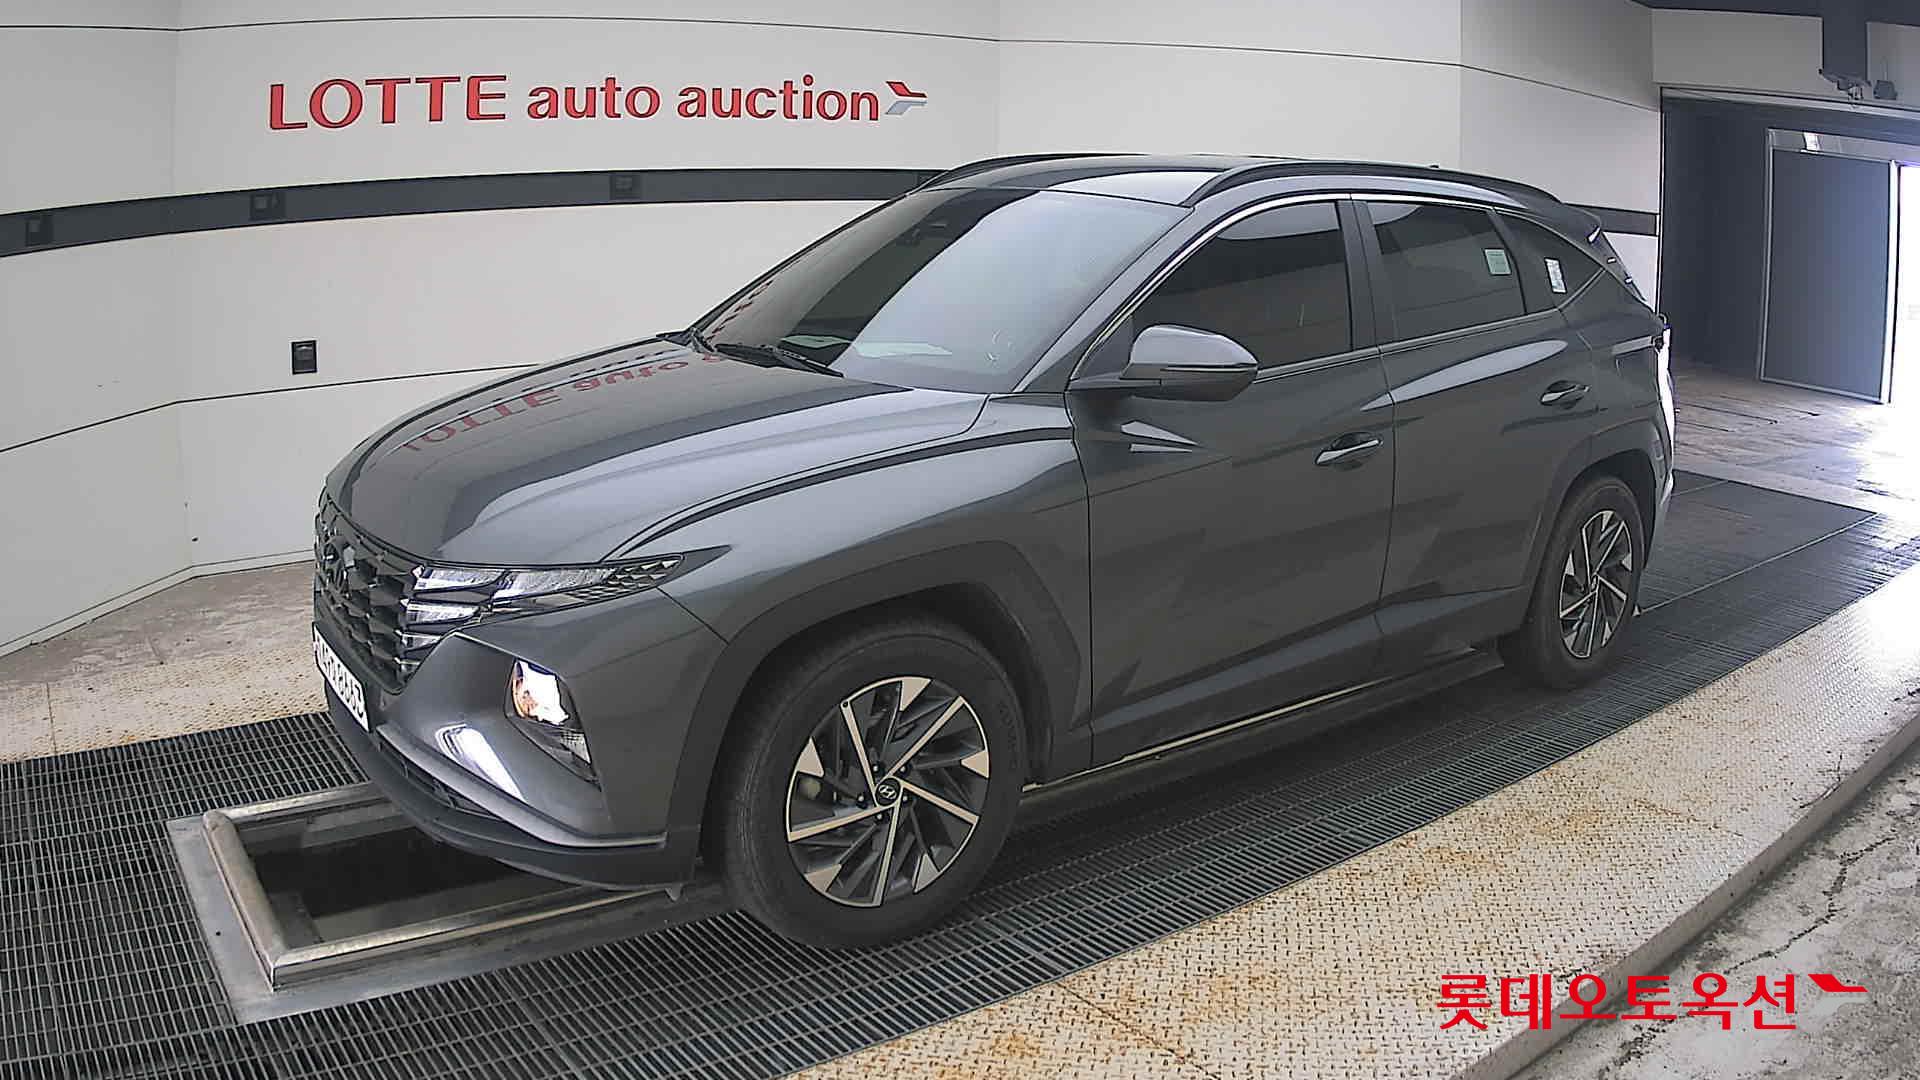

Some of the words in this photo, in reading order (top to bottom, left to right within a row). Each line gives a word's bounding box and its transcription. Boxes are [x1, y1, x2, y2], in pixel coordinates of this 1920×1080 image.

[268, 75, 506, 130] LOTTE
[527, 77, 661, 120] auto
[677, 74, 880, 121] auction
